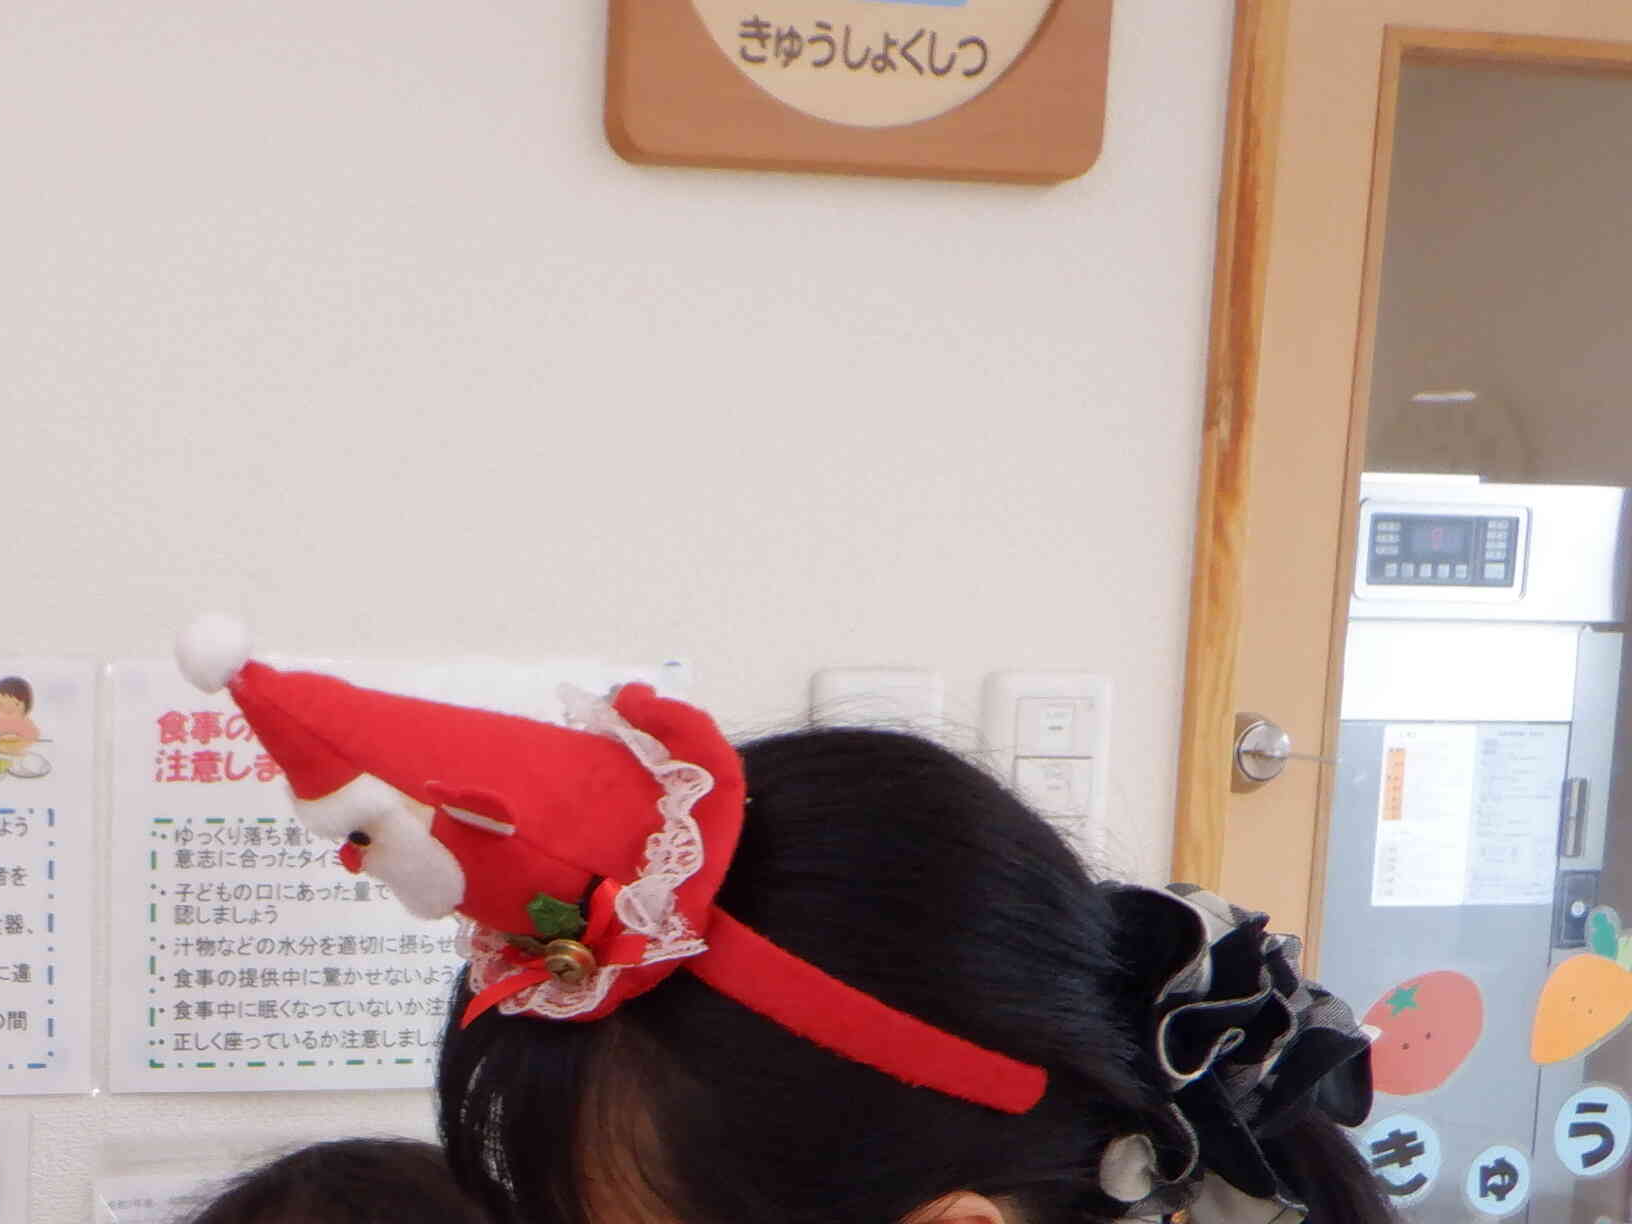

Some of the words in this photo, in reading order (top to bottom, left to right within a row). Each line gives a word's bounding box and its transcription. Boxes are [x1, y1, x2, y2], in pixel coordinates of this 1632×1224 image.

[736, 15, 990, 77] きゅうしょくしつ
[157, 710, 256, 744] 食事の
